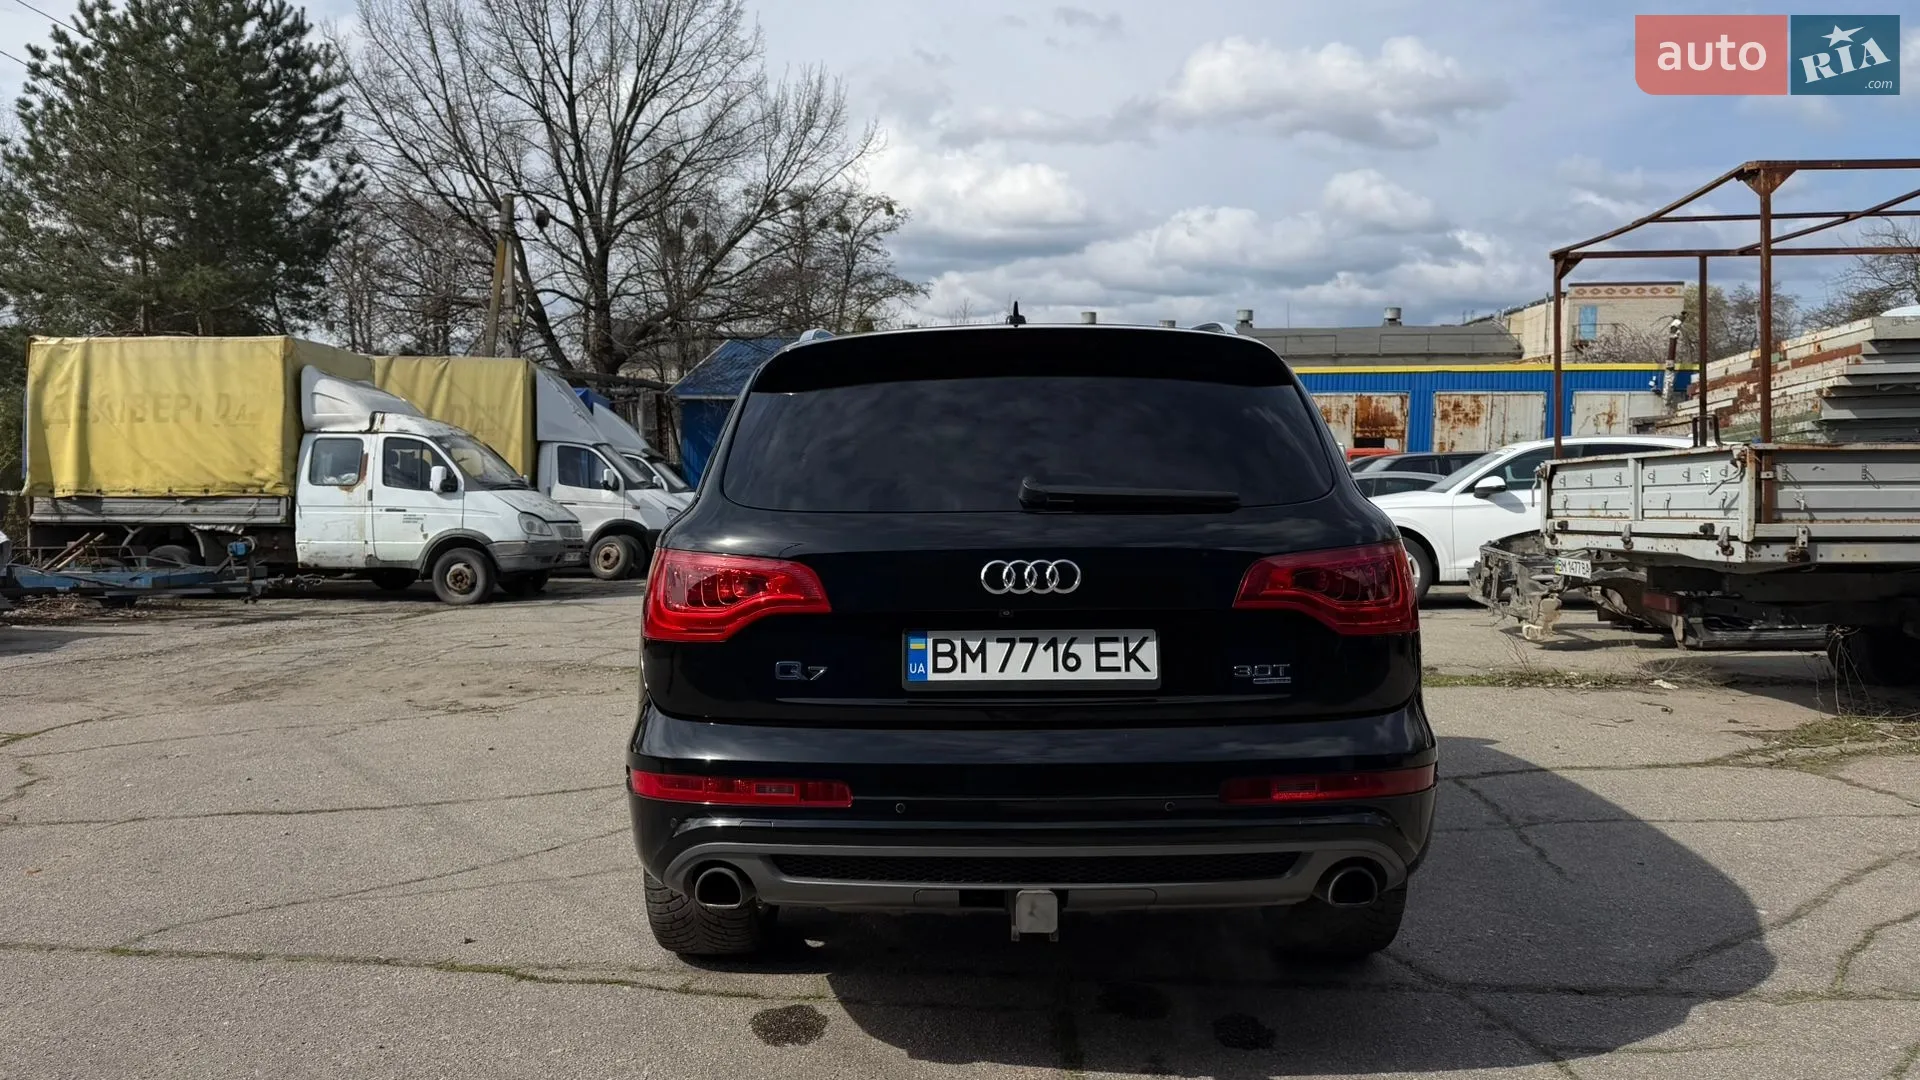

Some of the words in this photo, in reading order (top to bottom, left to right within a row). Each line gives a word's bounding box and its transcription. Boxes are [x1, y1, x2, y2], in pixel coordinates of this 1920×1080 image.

[931, 637, 988, 674] BM
[995, 636, 1082, 673] 7716
[1094, 636, 1152, 673] EK
[775, 661, 828, 680] Q7
[909, 662, 926, 674] UA
